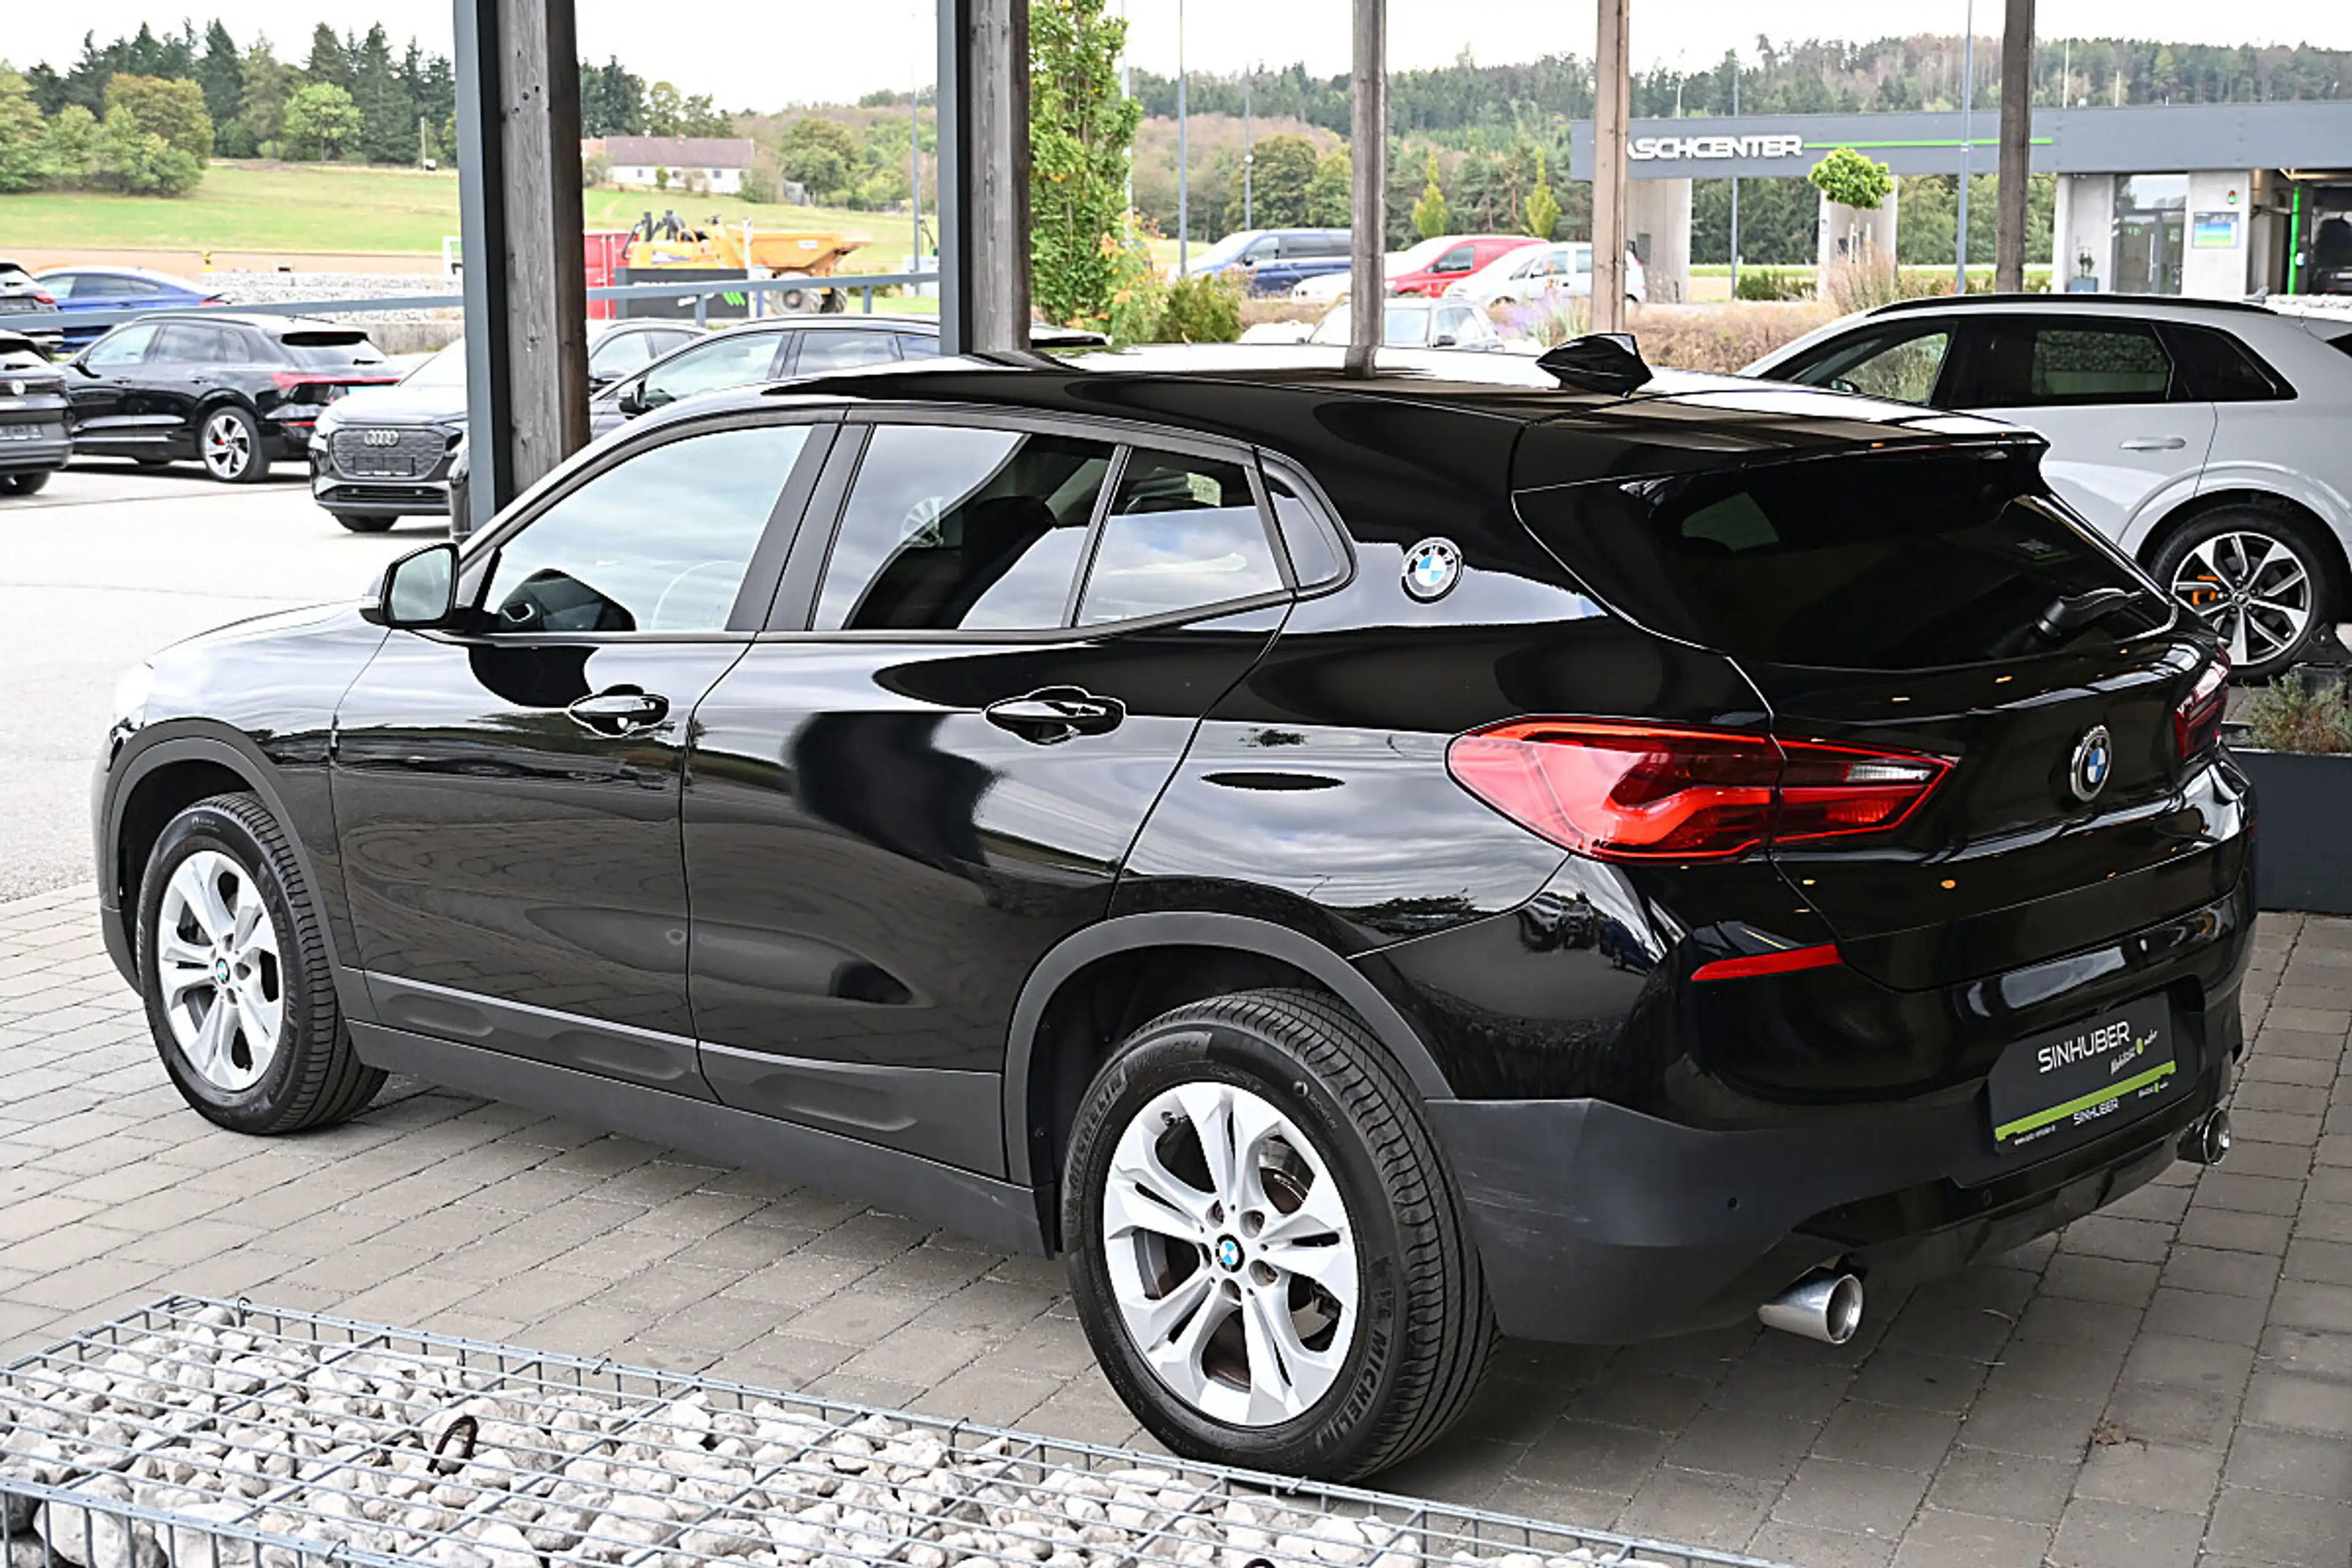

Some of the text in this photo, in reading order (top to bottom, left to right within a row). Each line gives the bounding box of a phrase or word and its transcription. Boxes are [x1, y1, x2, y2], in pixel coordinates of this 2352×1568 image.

[2038, 1020, 2130, 1073] SINHUBER
[2073, 1098, 2119, 1126] SINHUBER
[1316, 1328, 1388, 1450] MICHELIN
